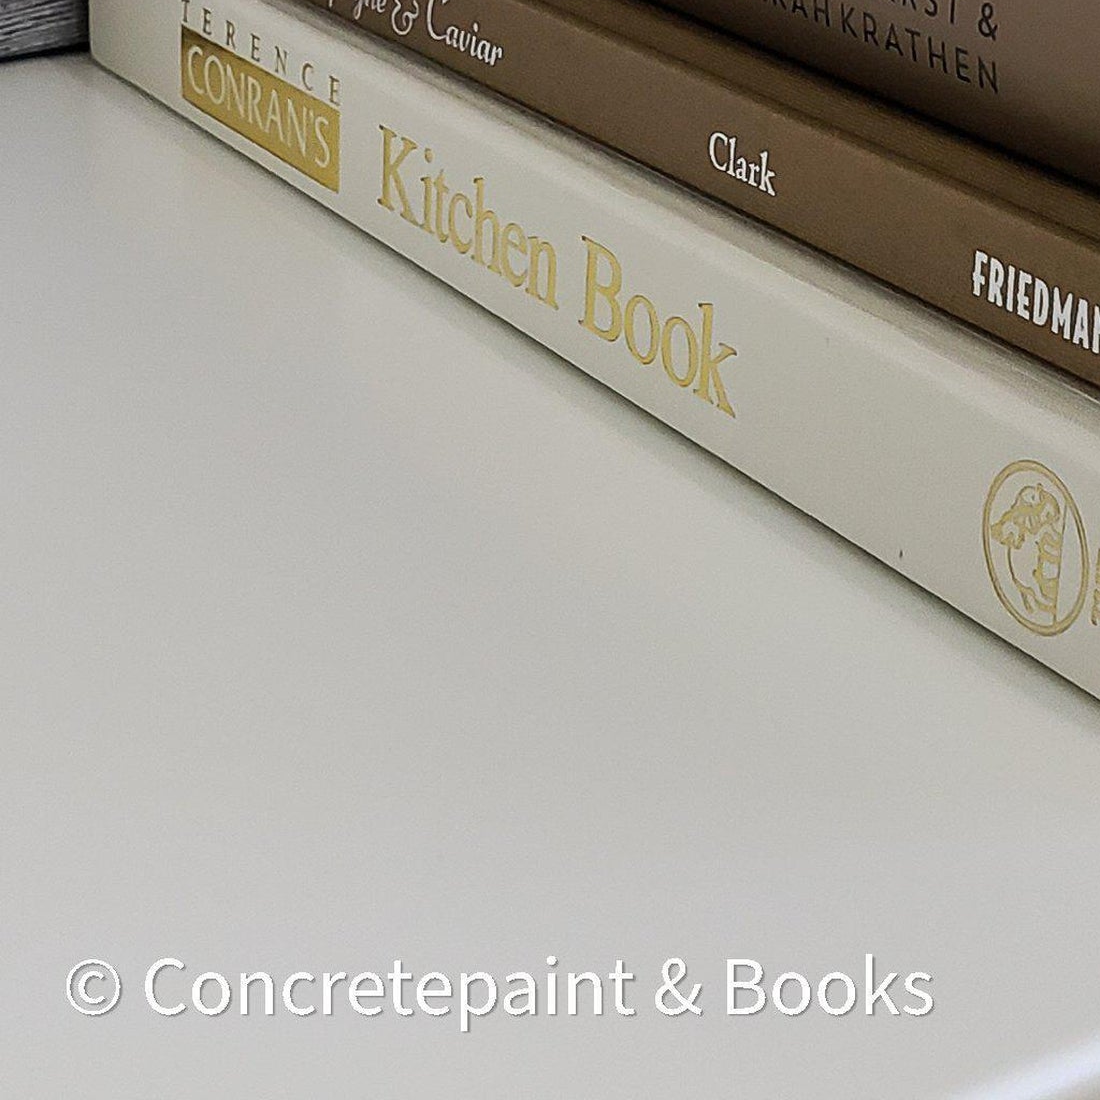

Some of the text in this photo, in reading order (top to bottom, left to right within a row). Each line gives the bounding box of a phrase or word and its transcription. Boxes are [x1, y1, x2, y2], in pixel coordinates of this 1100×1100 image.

[840, 2, 999, 95] KRATHEN
[977, 1, 999, 42] &
[187, 45, 331, 168] CONRAN'S
[708, 131, 777, 197] Clark
[376, 123, 738, 419] Kitchen Book
